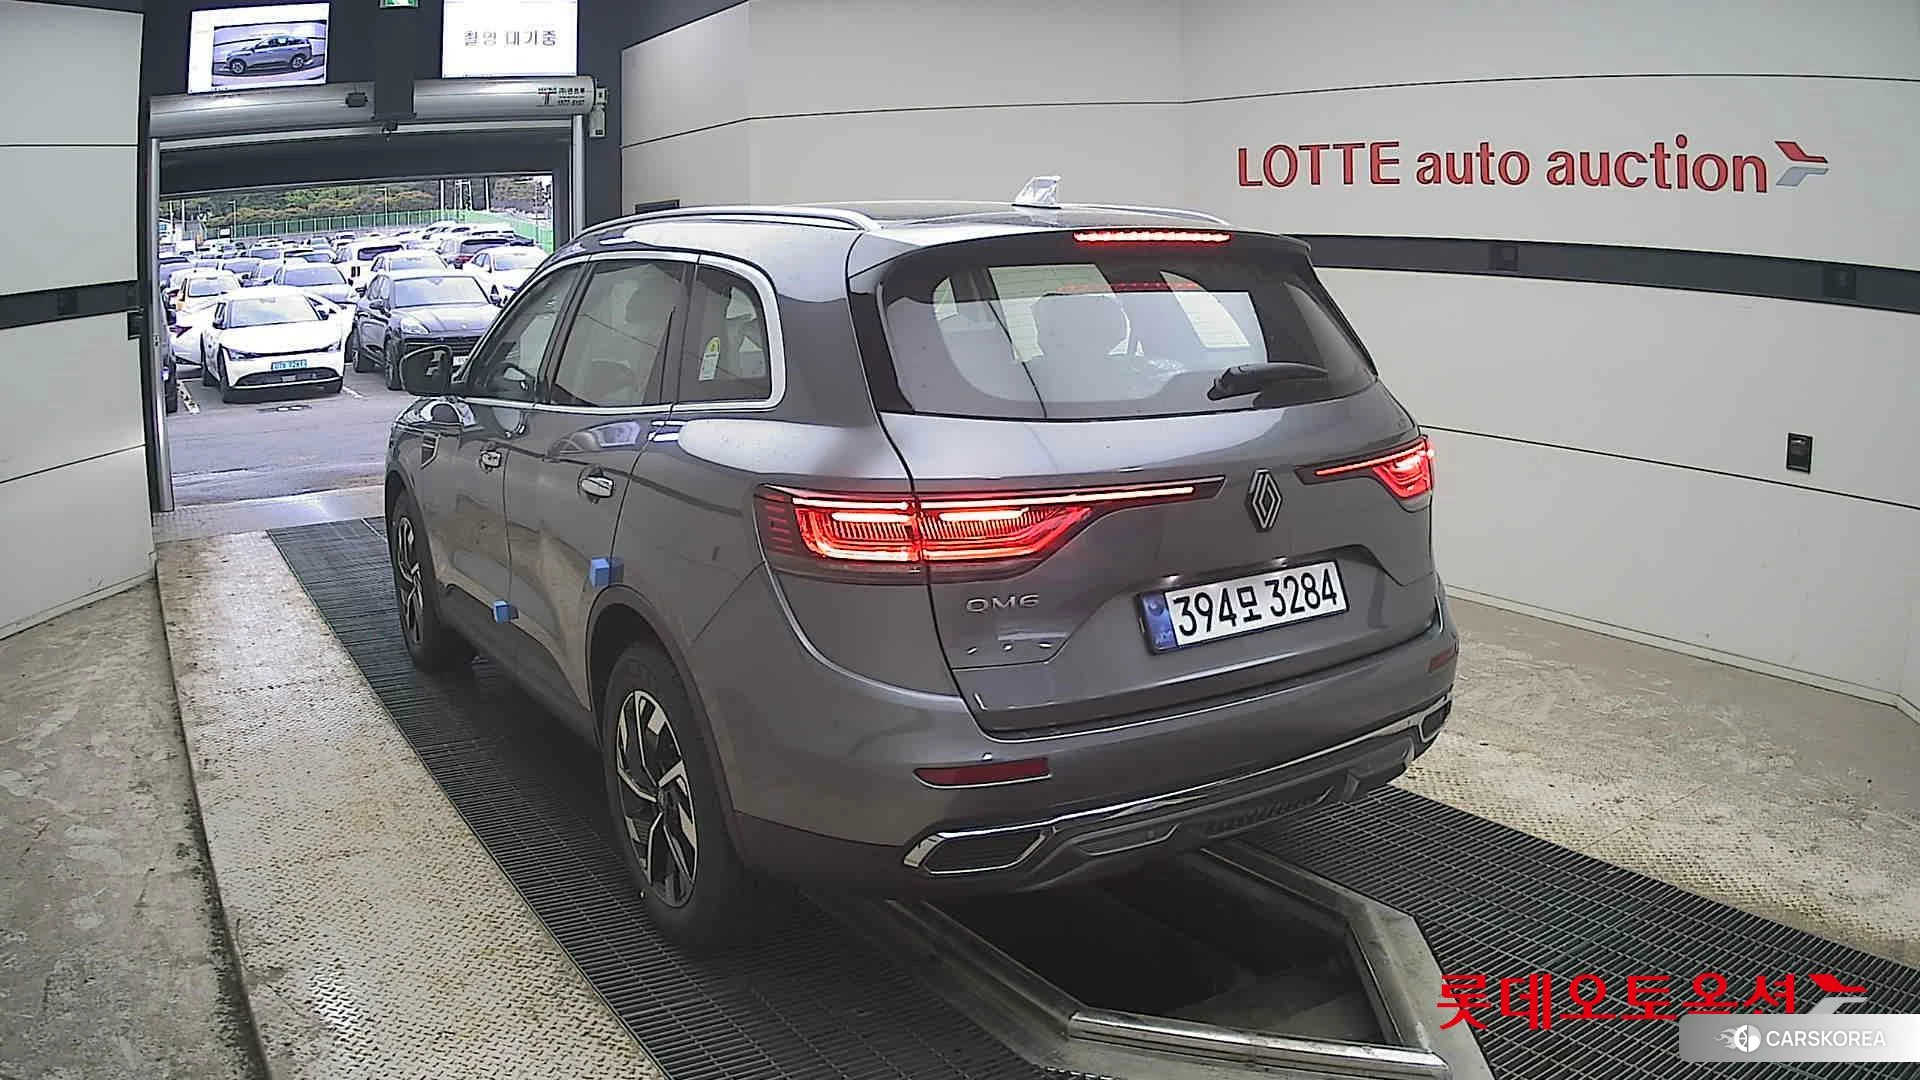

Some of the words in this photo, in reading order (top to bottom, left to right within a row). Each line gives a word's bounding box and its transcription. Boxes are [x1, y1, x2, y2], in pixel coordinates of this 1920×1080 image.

[504, 30, 557, 47] 대기중
[1238, 141, 1400, 188] LOTTE
[1414, 141, 1530, 186] auto
[1545, 134, 1768, 193] auction
[966, 594, 1040, 613] QM6
[1173, 586, 1263, 637] 394모
[1264, 568, 1338, 617] 3284
